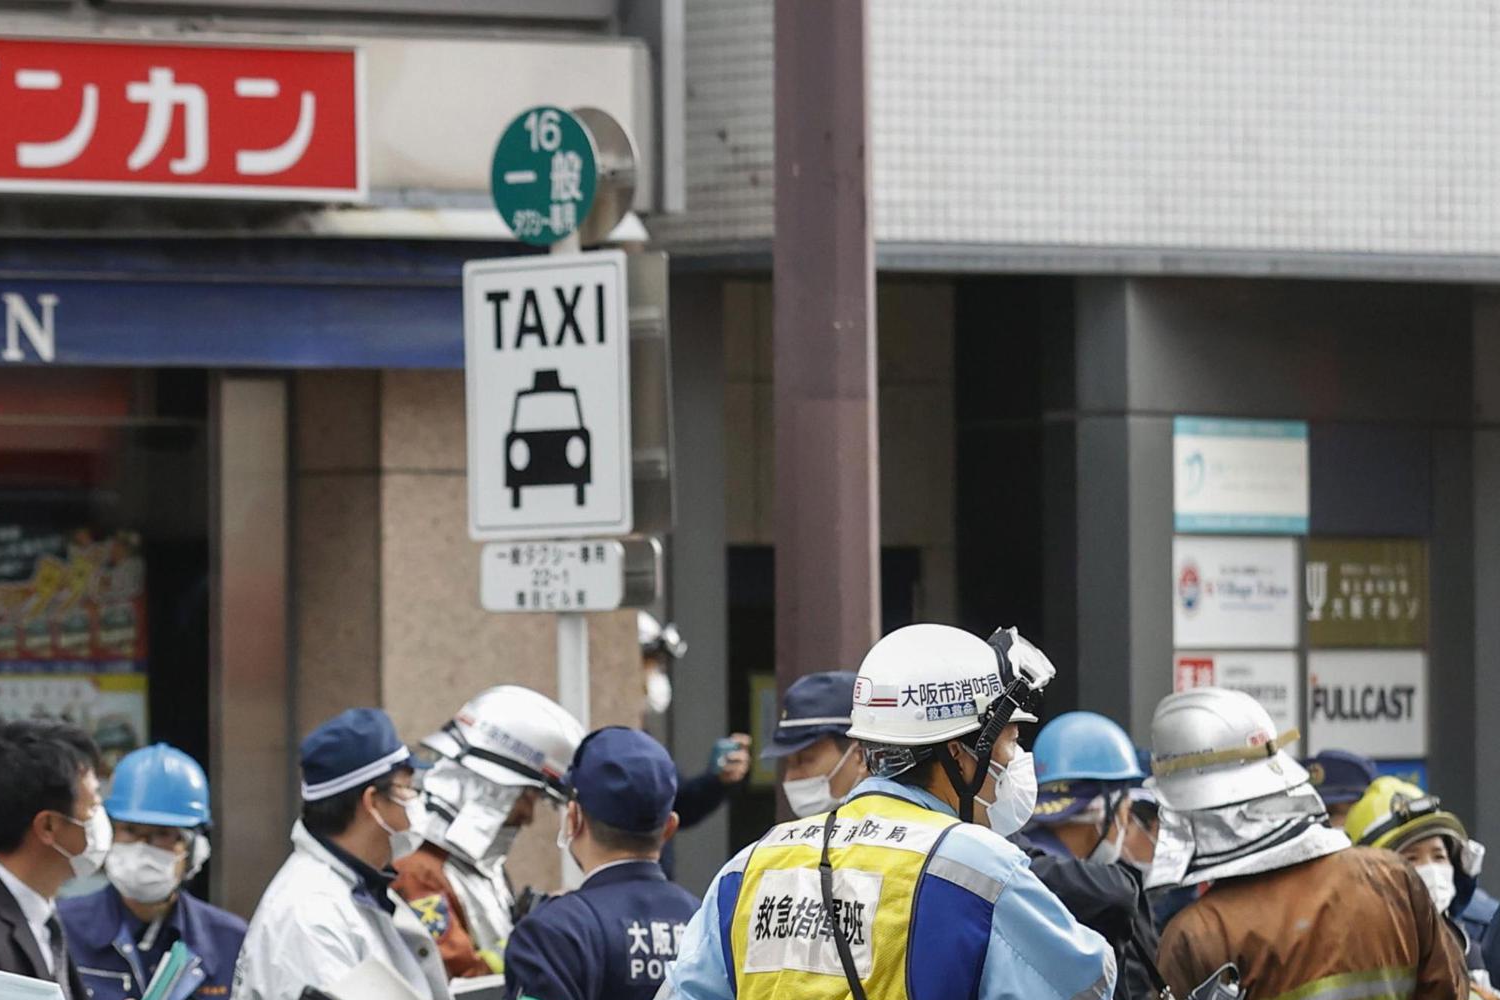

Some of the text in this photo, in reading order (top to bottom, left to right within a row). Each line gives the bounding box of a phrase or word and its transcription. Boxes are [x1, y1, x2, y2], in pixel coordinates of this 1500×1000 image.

[524, 110, 562, 152] 16
[503, 151, 583, 201] 一般
[485, 285, 607, 350] TAXI
[901, 673, 1003, 707] 大阪市消防局
[1311, 684, 1415, 721] FULLCAST
